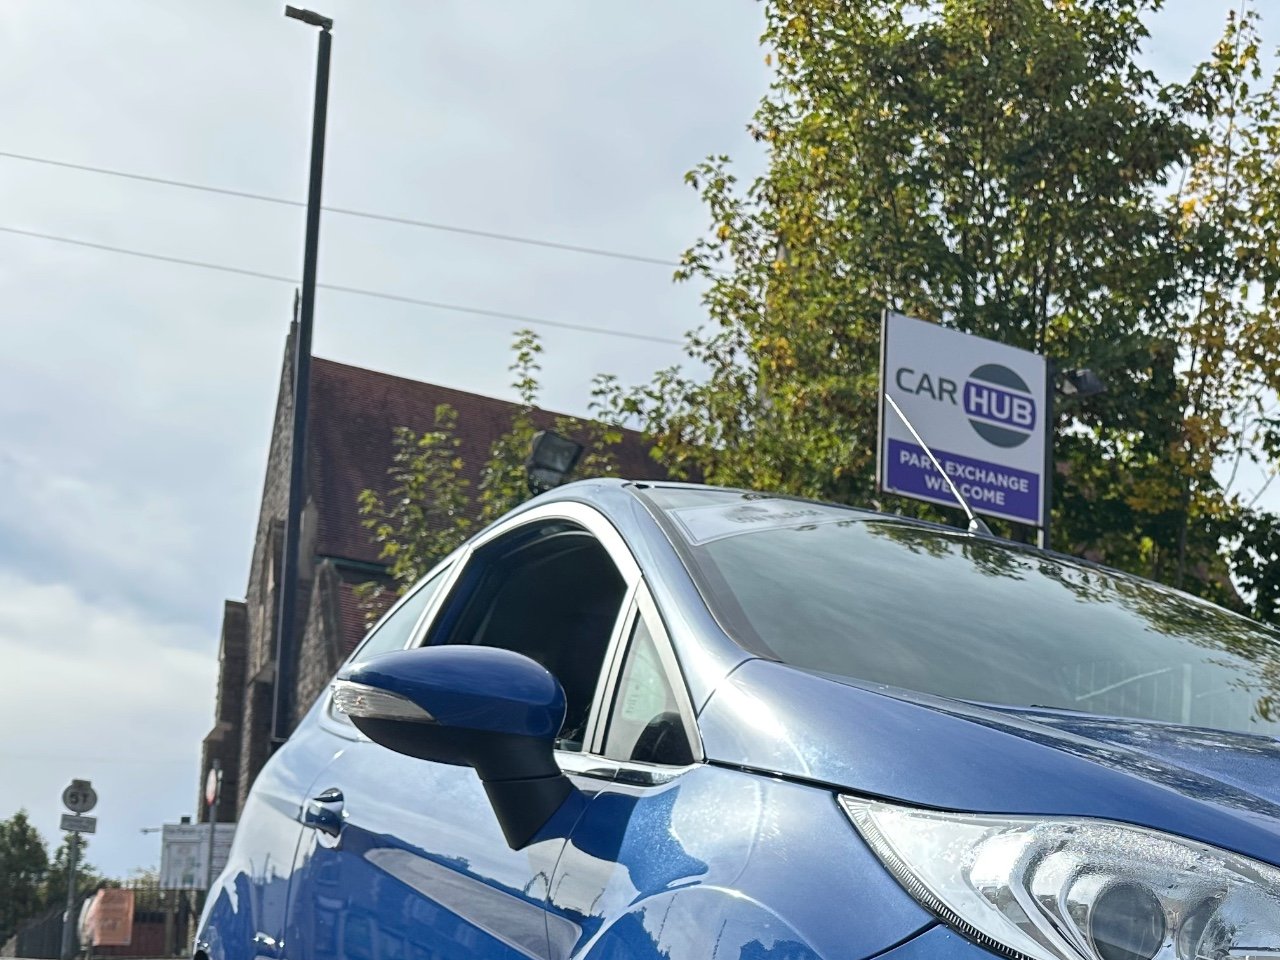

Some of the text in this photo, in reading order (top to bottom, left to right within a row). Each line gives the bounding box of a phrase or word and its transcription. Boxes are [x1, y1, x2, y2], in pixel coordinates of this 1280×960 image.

[895, 368, 1033, 426] CAR HUB
[945, 460, 1029, 493] EXCHANGE
